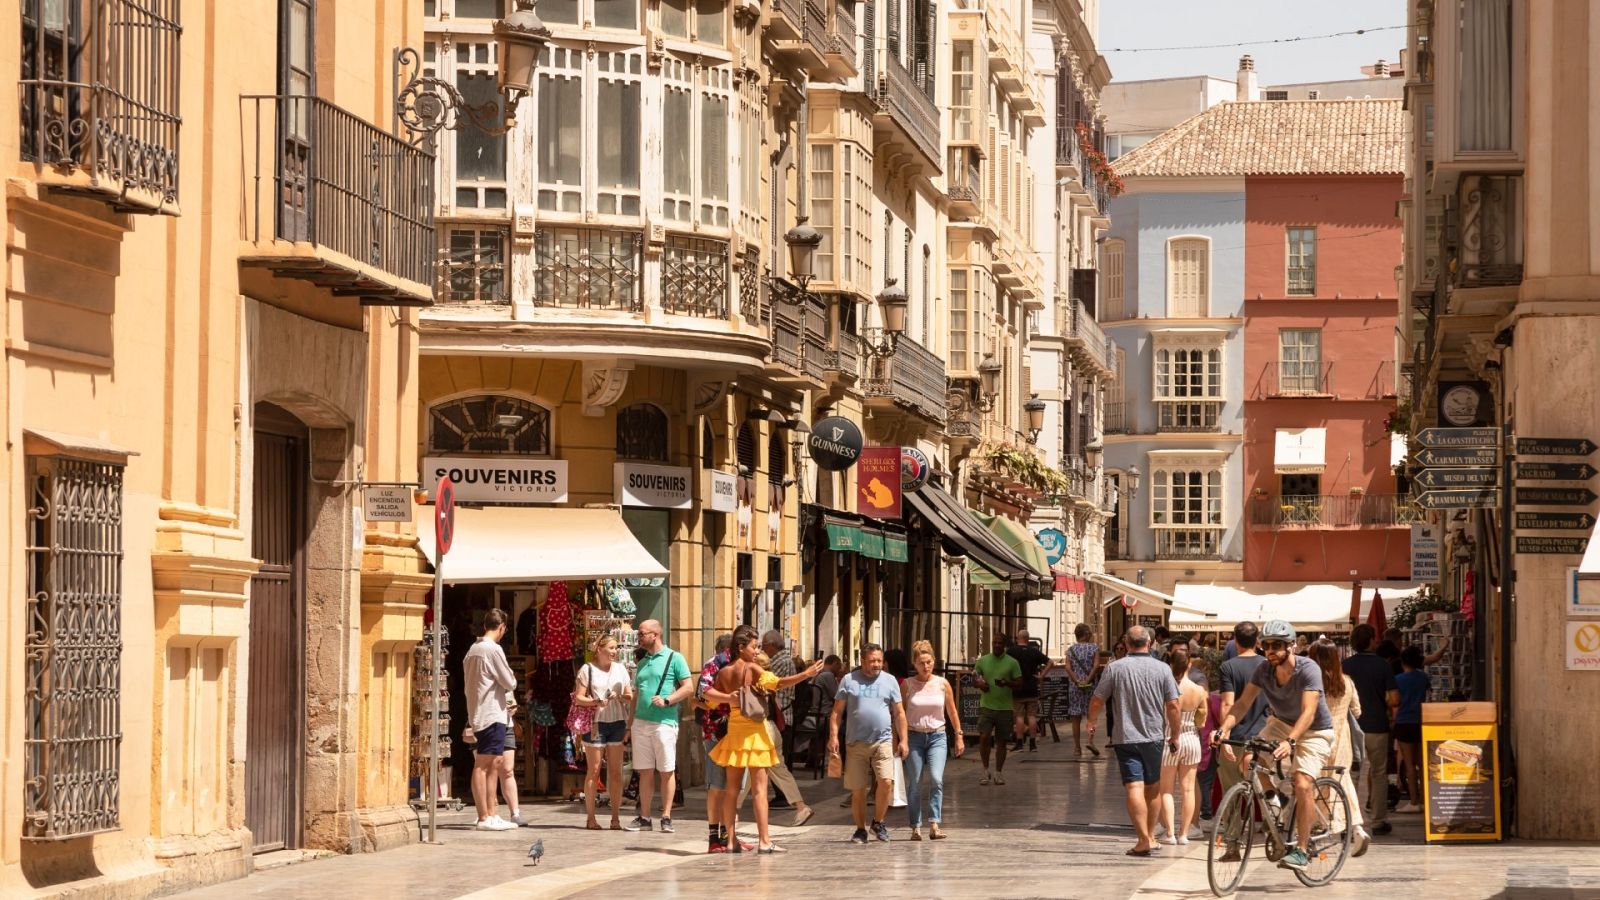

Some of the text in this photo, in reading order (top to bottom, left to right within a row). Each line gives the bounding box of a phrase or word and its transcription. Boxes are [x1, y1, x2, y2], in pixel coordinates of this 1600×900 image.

[1437, 437, 1446, 445] LA
[811, 435, 856, 459] GUINNESS
[1519, 445, 1550, 454] PICASSO
[861, 457, 897, 465] SHERLOCK
[1434, 457, 1495, 465] CARMEN THYSSEN
[863, 465, 896, 473] HOLMES
[435, 468, 557, 485] SOUVENIRS
[1443, 474, 1465, 482] MUSEO
[1467, 474, 1479, 482] DEL
[1519, 470, 1556, 479] SAGRARIO
[629, 473, 686, 492] SOUVENIRS
[495, 485, 557, 493] VICTORIA
[714, 479, 733, 497] SOUVENIRS
[656, 490, 686, 499] VICTORIA
[1434, 496, 1465, 504] HAMMAM
[1518, 520, 1577, 528] REVELLO DE TORO
[1553, 538, 1579, 546] PICASSO
[1519, 545, 1576, 553] MUSEO CASA NATAL
